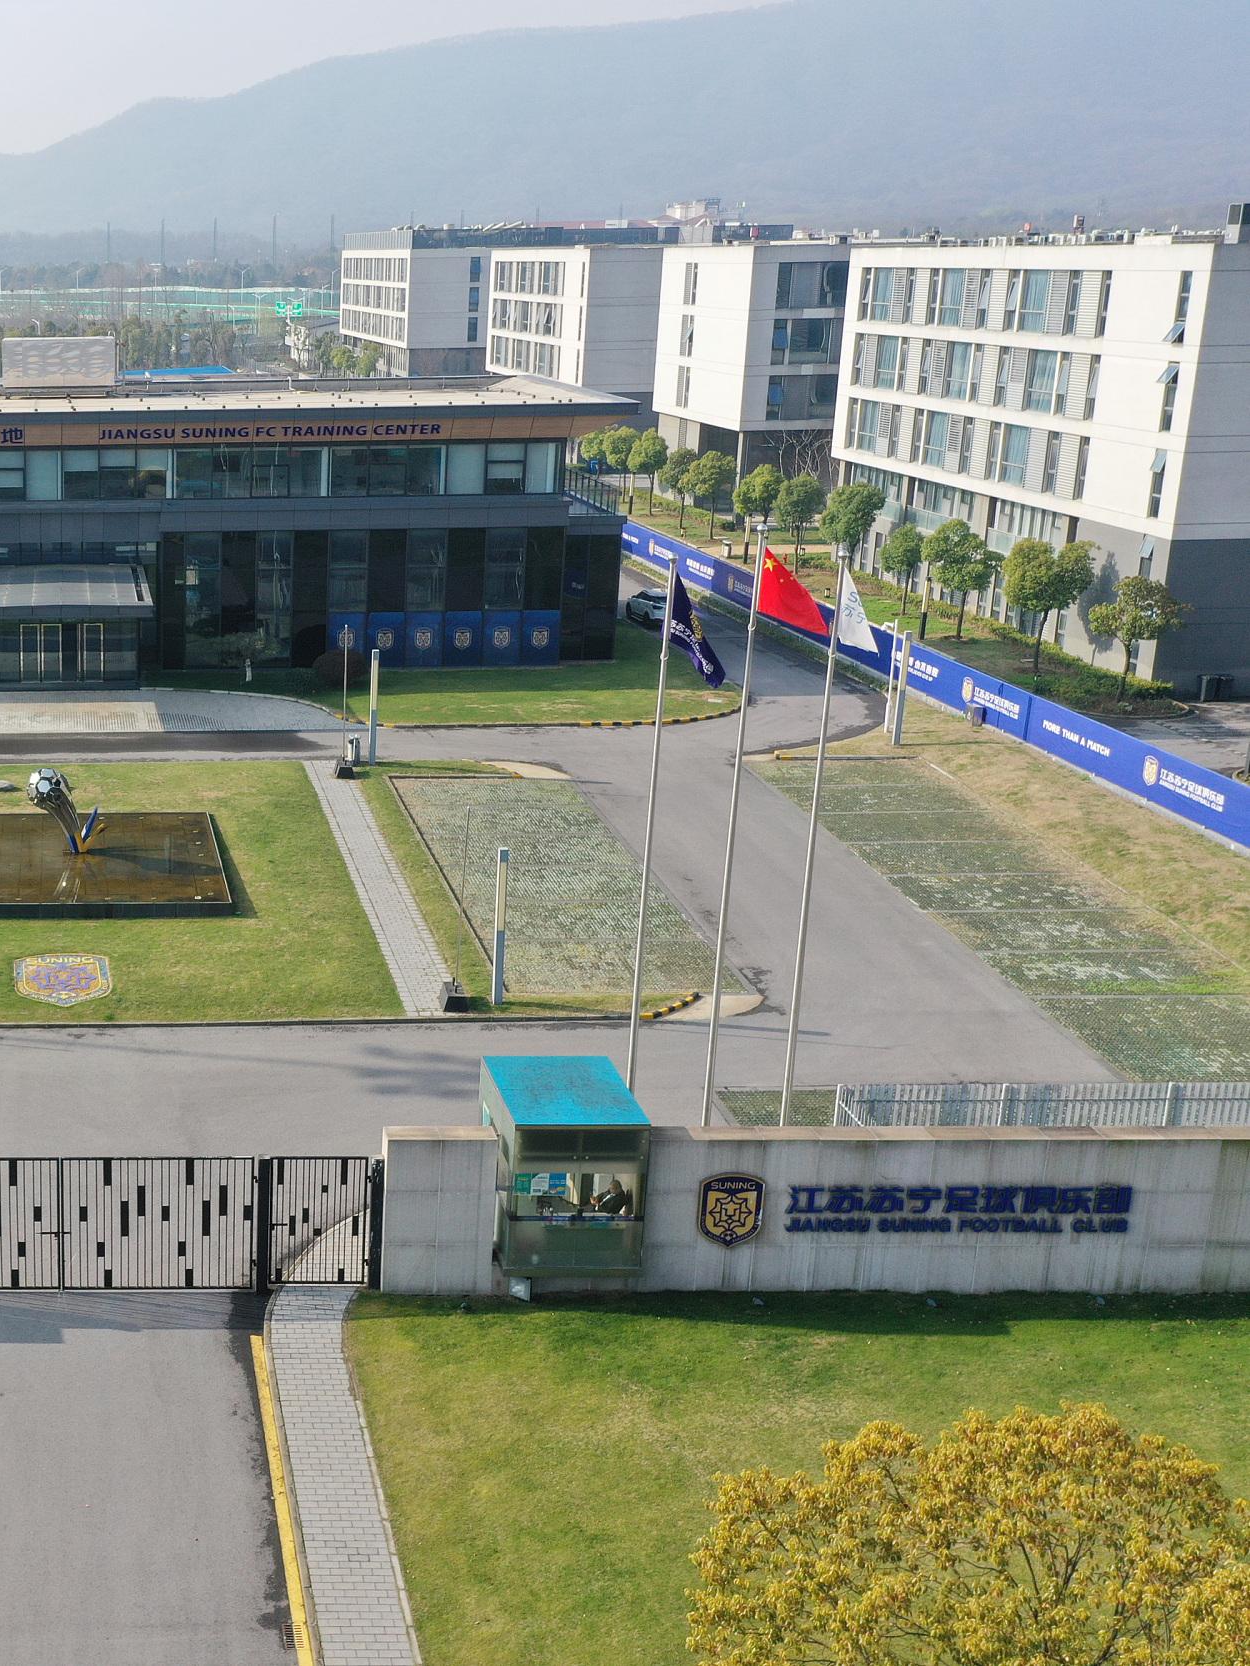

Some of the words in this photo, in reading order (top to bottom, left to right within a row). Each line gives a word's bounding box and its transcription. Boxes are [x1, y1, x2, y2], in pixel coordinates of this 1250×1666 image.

[99, 428, 175, 440] JIANGSU
[181, 426, 249, 438] SUNING
[255, 426, 275, 438] FC
[281, 425, 367, 437] TRAINING
[373, 423, 441, 436] CENTER
[1042, 719, 1061, 735] MORE
[1062, 728, 1079, 744] THAN
[1080, 737, 1086, 747] A
[1086, 739, 1110, 757] MATCH
[1160, 768, 1224, 806] 江苏苏宁足球俱乐部
[26, 956, 94, 965] SUNING
[711, 1181, 756, 1190] SUNING
[784, 1183, 1134, 1215] 江苏苏宁足球俱乐部
[783, 1217, 871, 1234] JIANGSU
[876, 1217, 952, 1234] SUNING
[956, 1217, 1064, 1233] FOOTBALL
[1072, 1217, 1129, 1233] CLUB
